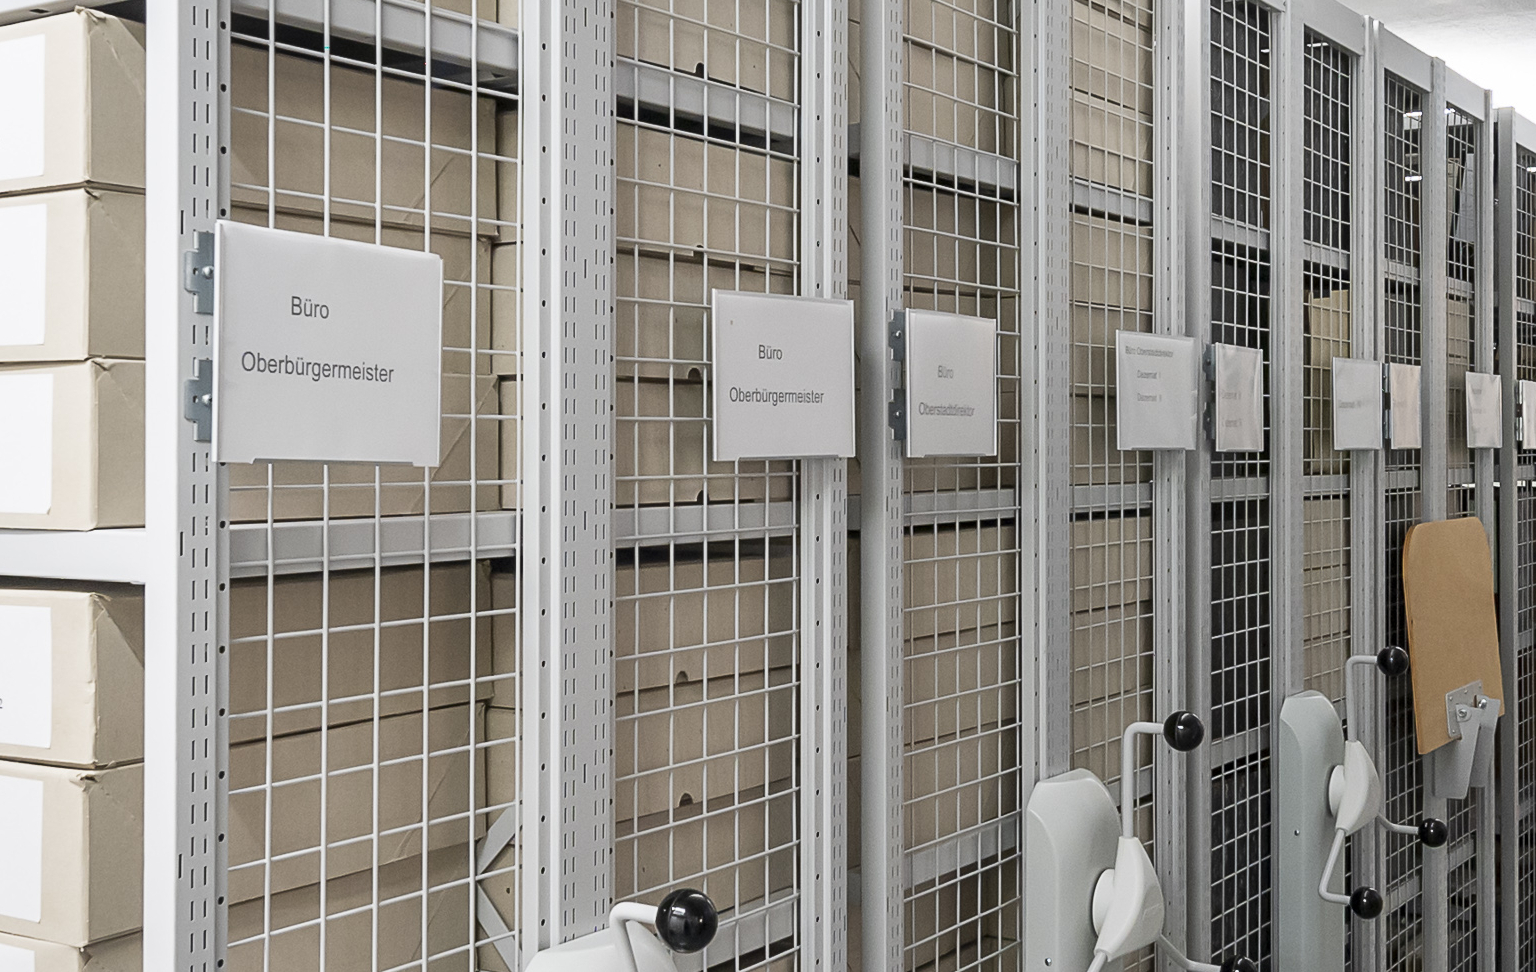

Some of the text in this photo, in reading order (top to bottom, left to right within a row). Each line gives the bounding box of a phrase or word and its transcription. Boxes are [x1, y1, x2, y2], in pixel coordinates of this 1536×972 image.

[291, 296, 330, 319] Büro
[758, 344, 783, 360] Büro
[241, 351, 394, 383] Oberbürgermeister
[937, 365, 954, 379] Büro
[729, 386, 825, 406] Oberbürgermeister
[918, 402, 975, 417] Oberstadtdirektor
